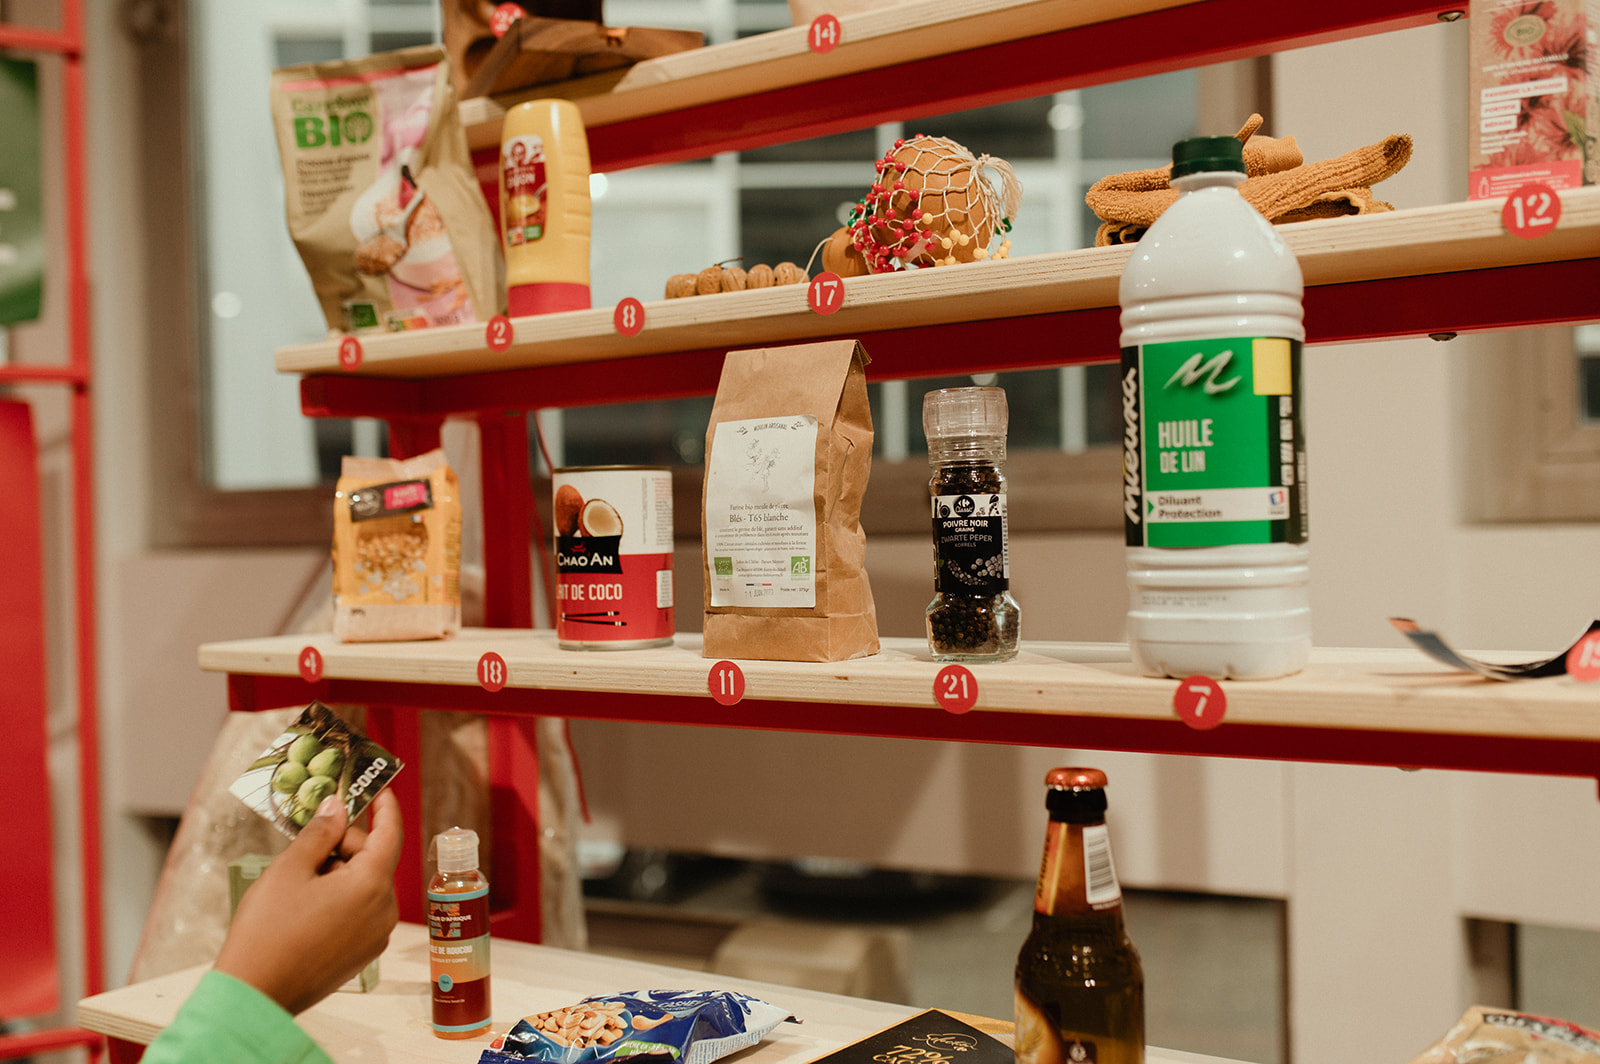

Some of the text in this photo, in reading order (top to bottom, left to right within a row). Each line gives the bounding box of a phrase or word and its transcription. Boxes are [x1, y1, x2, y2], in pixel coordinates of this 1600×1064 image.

[814, 21, 836, 47] 14
[294, 111, 373, 149] BIO
[1512, 193, 1553, 228] 12
[814, 281, 838, 307] 17
[622, 305, 636, 328] 8
[494, 322, 507, 345] 2
[343, 342, 357, 363] 3
[1158, 418, 1214, 449] HUILE
[1160, 450, 1206, 474] DE LIN
[1158, 496, 1202, 506] Diluant
[748, 513, 763, 522] T65
[763, 513, 789, 521] blanche
[943, 520, 968, 528] POIVRE
[1158, 509, 1223, 519] Protection
[941, 534, 993, 543] ZWARTE PEPER
[792, 560, 808, 573] AB
[571, 584, 585, 600] DE
[589, 583, 623, 600] COCO
[303, 651, 317, 674] 4
[482, 660, 502, 684] 18
[718, 670, 736, 696] 11
[942, 674, 968, 699] 21
[1189, 685, 1211, 717] 7
[349, 757, 388, 797] COCO
[438, 946, 446, 954] DE
